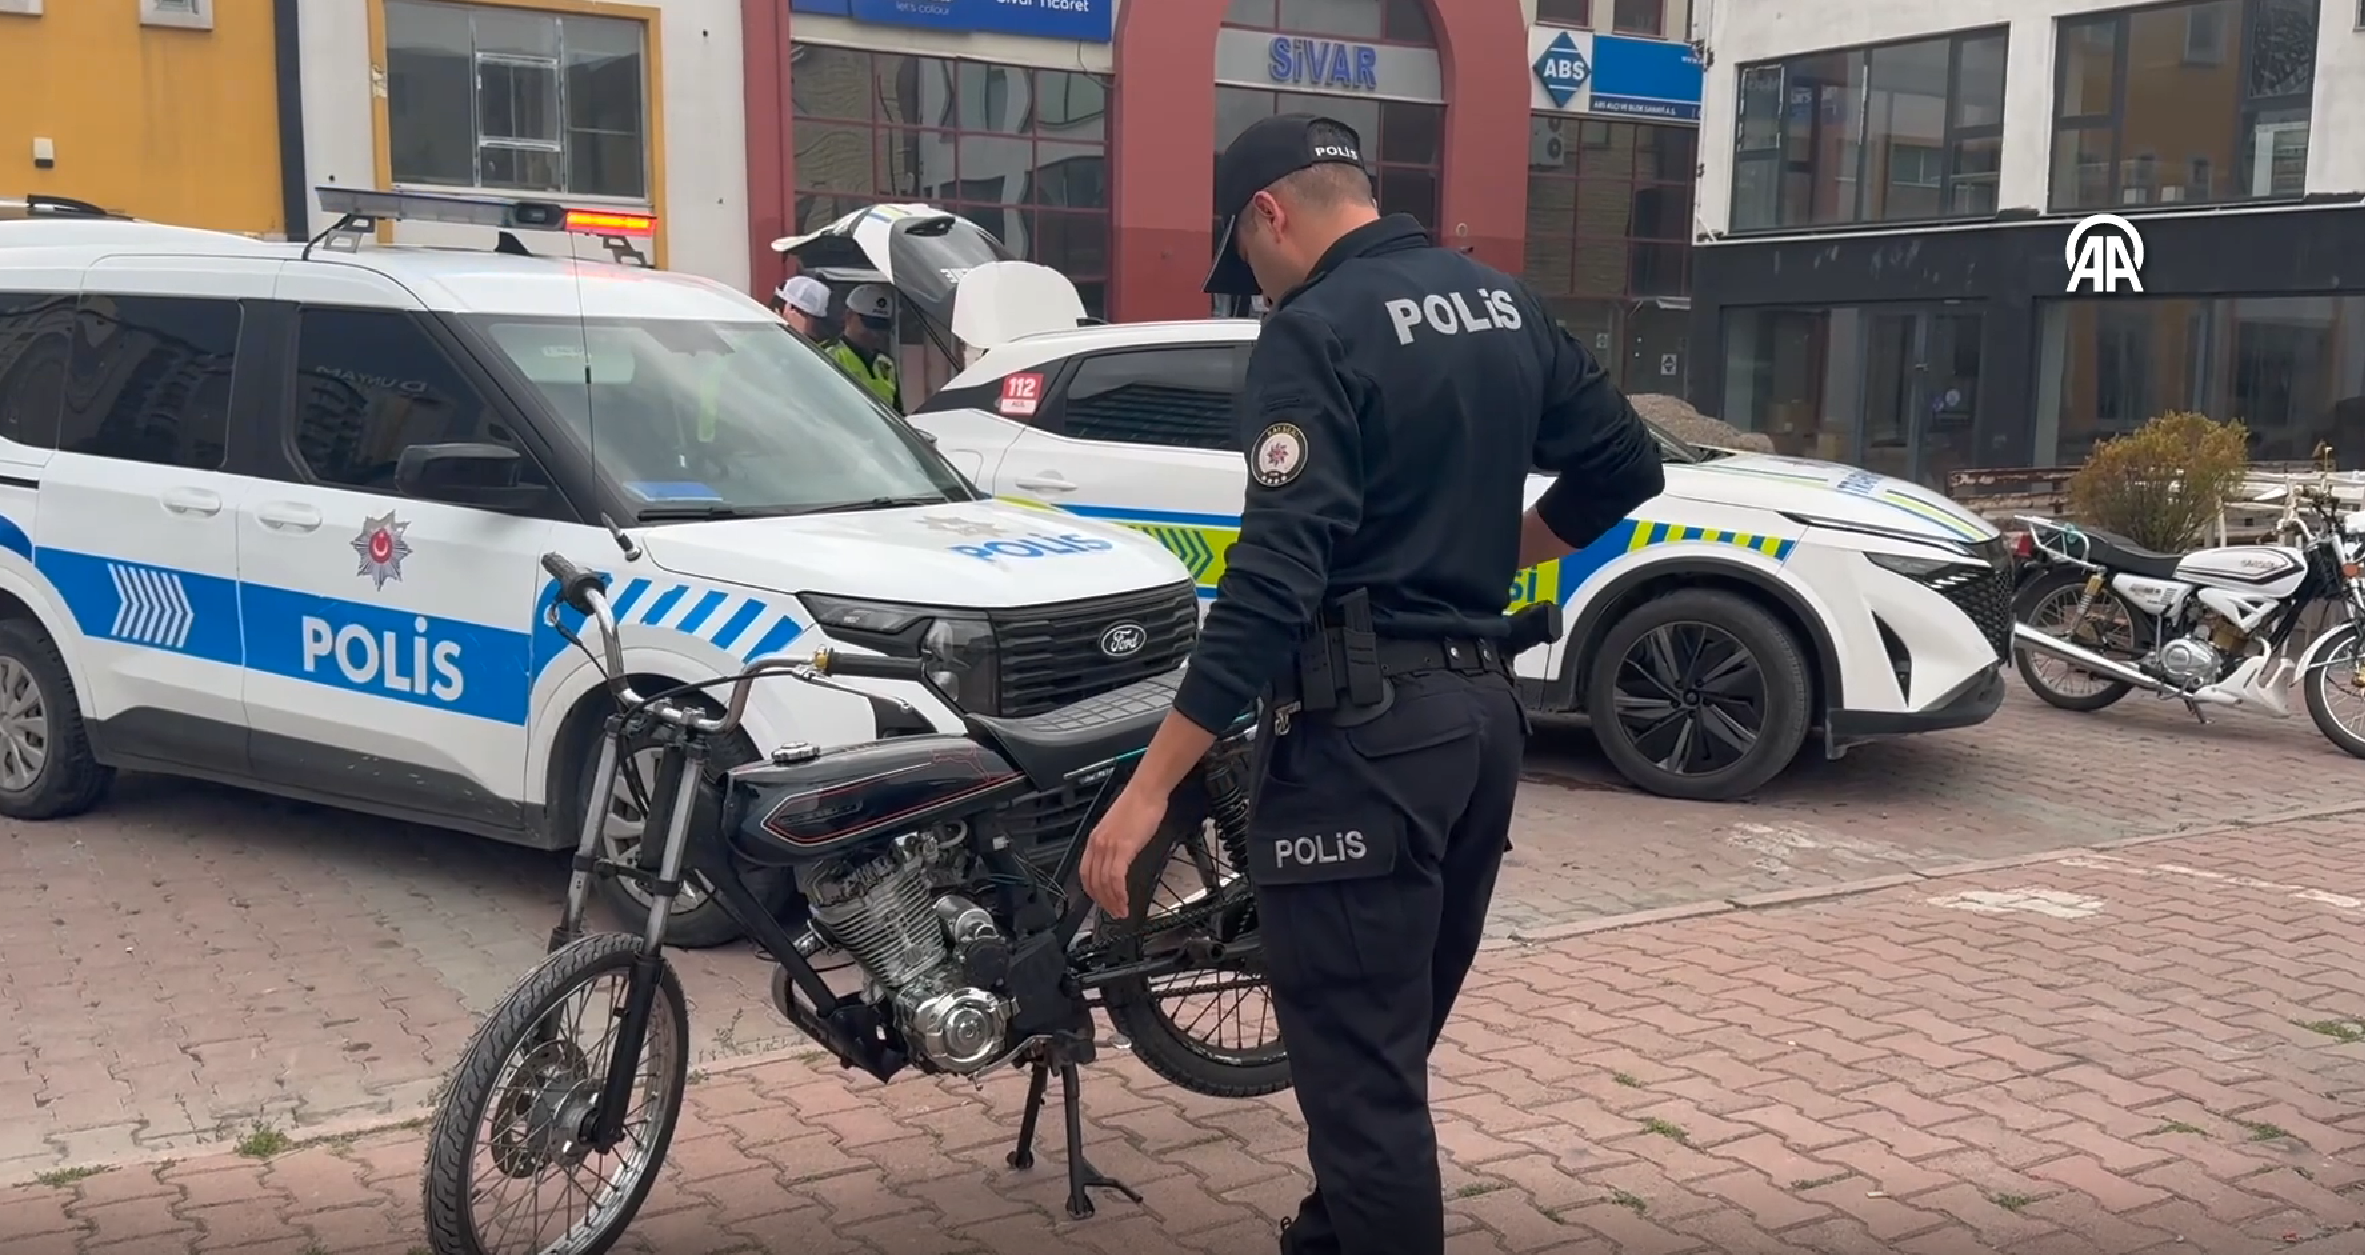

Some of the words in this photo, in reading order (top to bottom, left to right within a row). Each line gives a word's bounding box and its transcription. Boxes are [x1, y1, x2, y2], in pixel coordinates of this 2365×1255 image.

[1543, 59, 1585, 81] ABS
[1008, 377, 1037, 397] 112
[1111, 629, 1138, 652] Ford
